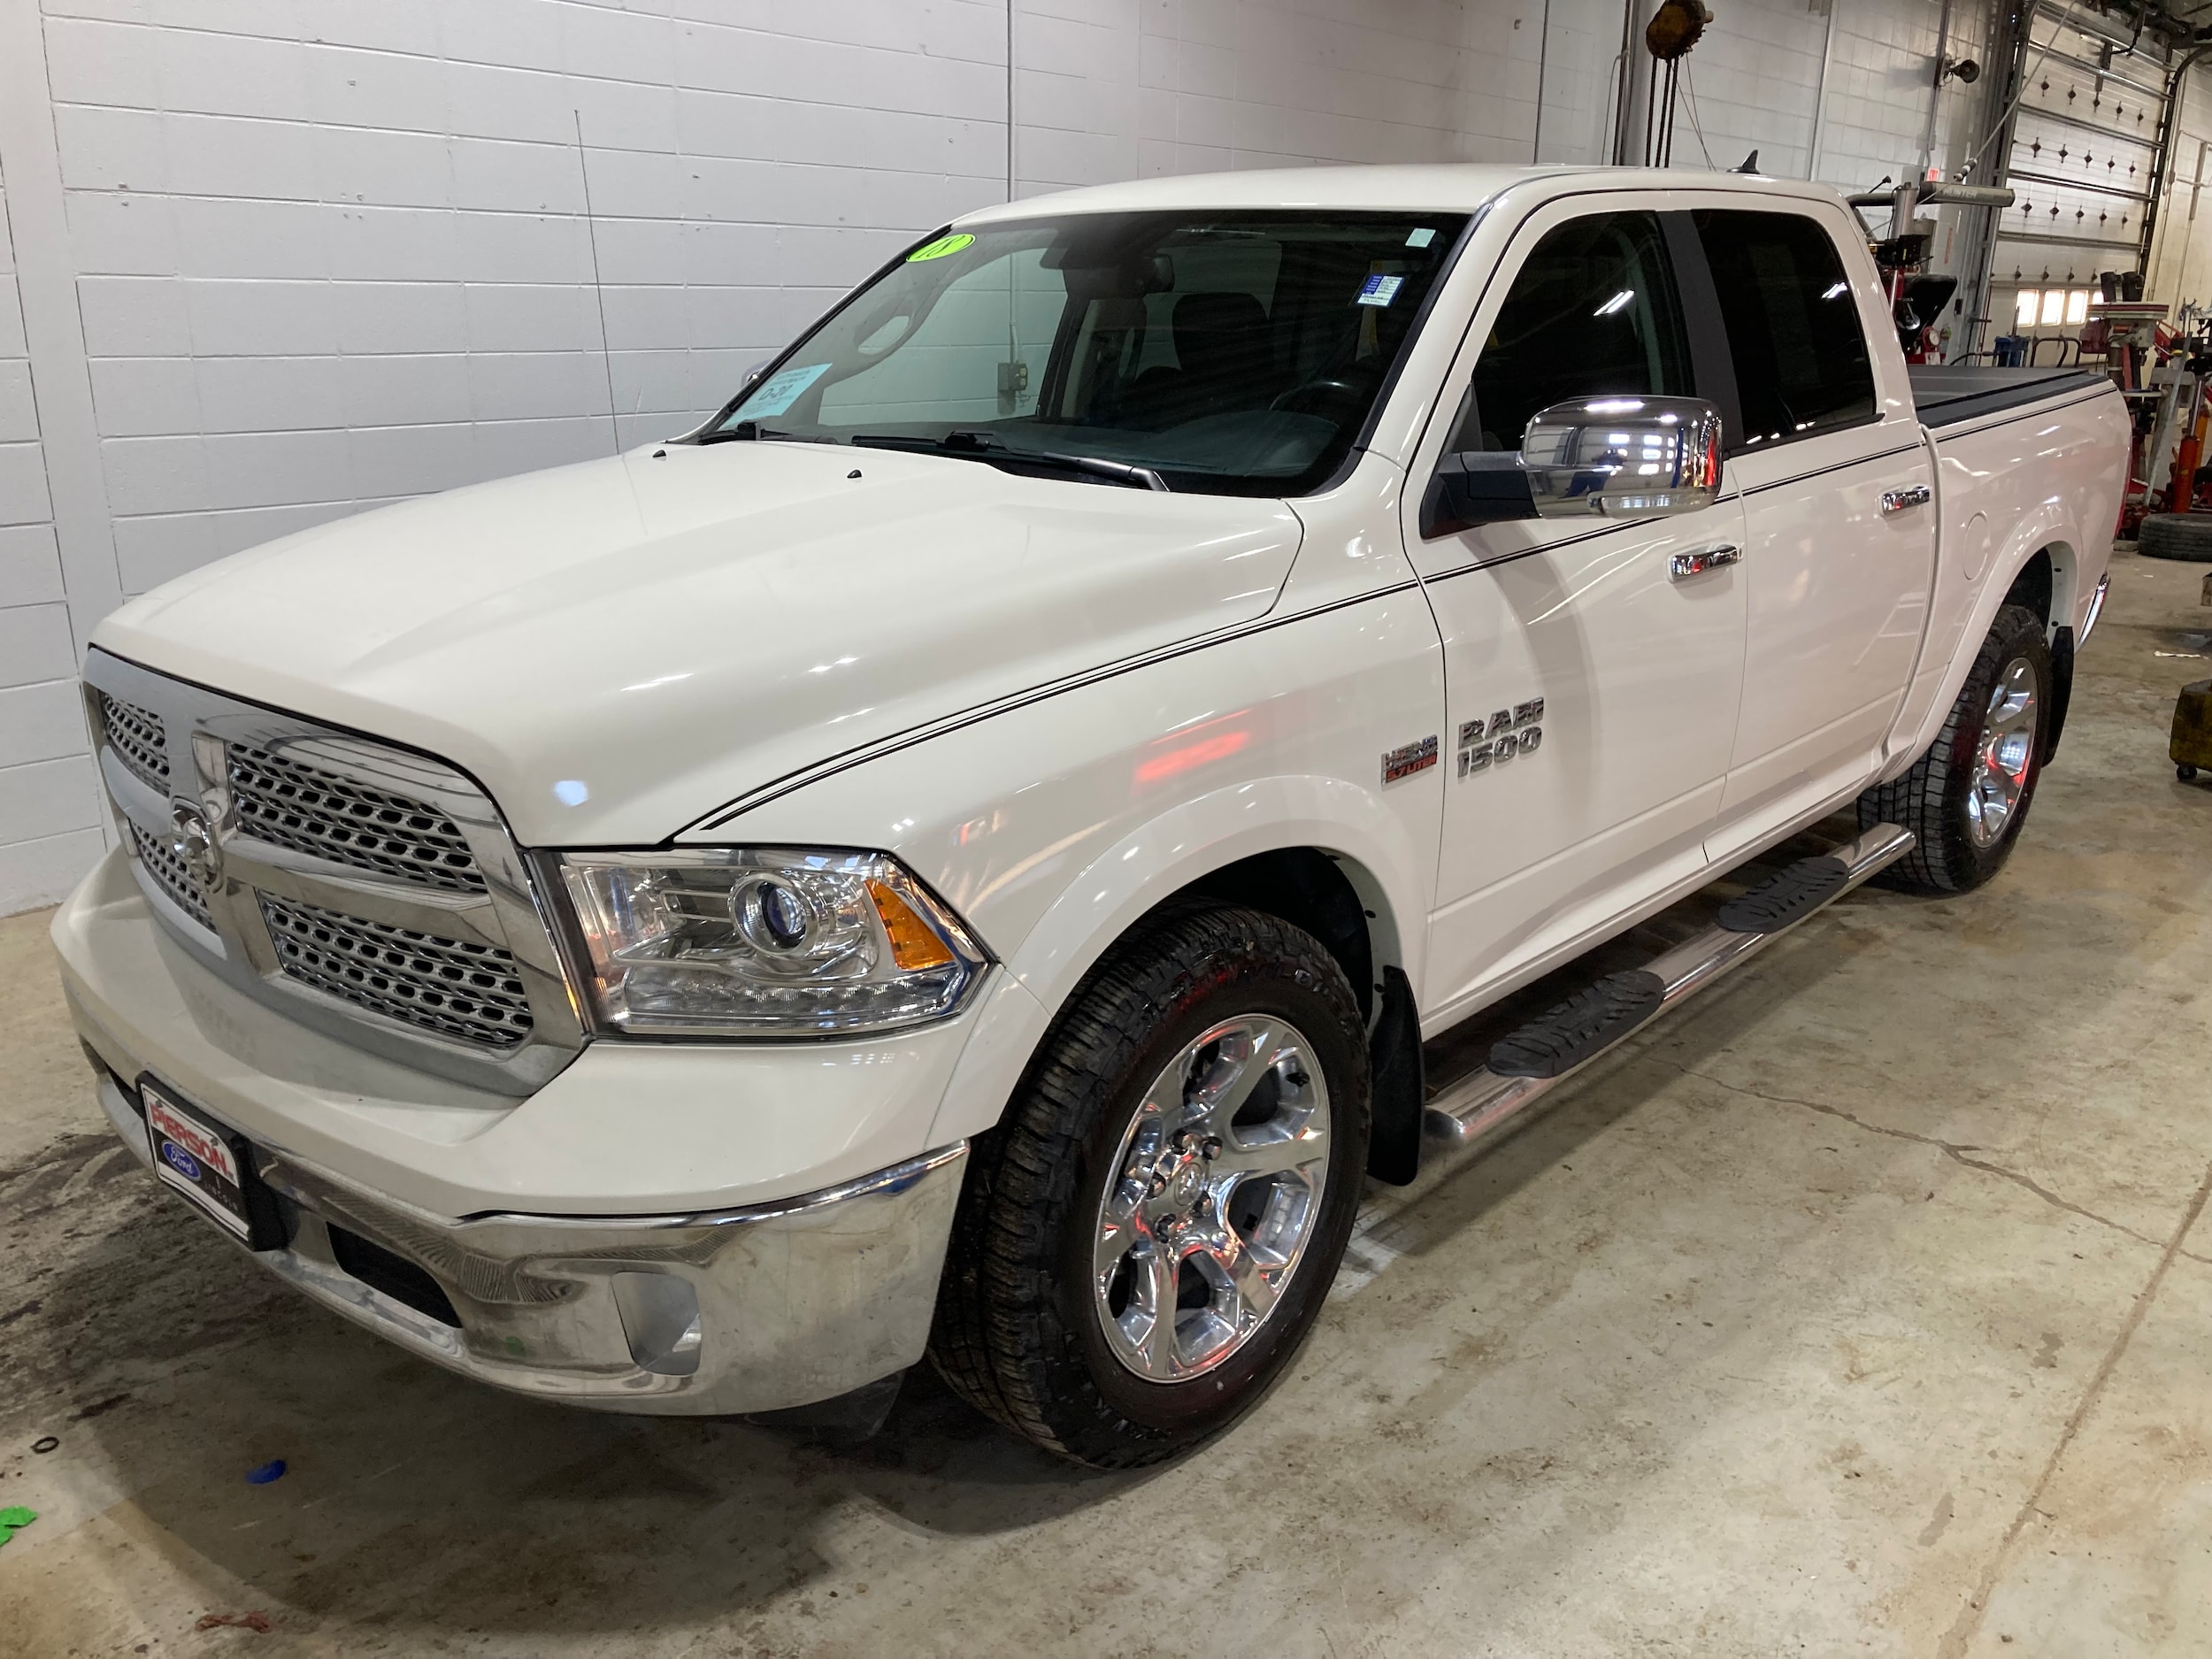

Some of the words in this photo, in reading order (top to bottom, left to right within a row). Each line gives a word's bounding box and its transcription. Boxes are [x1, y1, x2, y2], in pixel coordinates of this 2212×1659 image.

[1458, 696, 1544, 750] RAM
[1457, 726, 1542, 778] 1500
[150, 1102, 228, 1175] PIERSON
